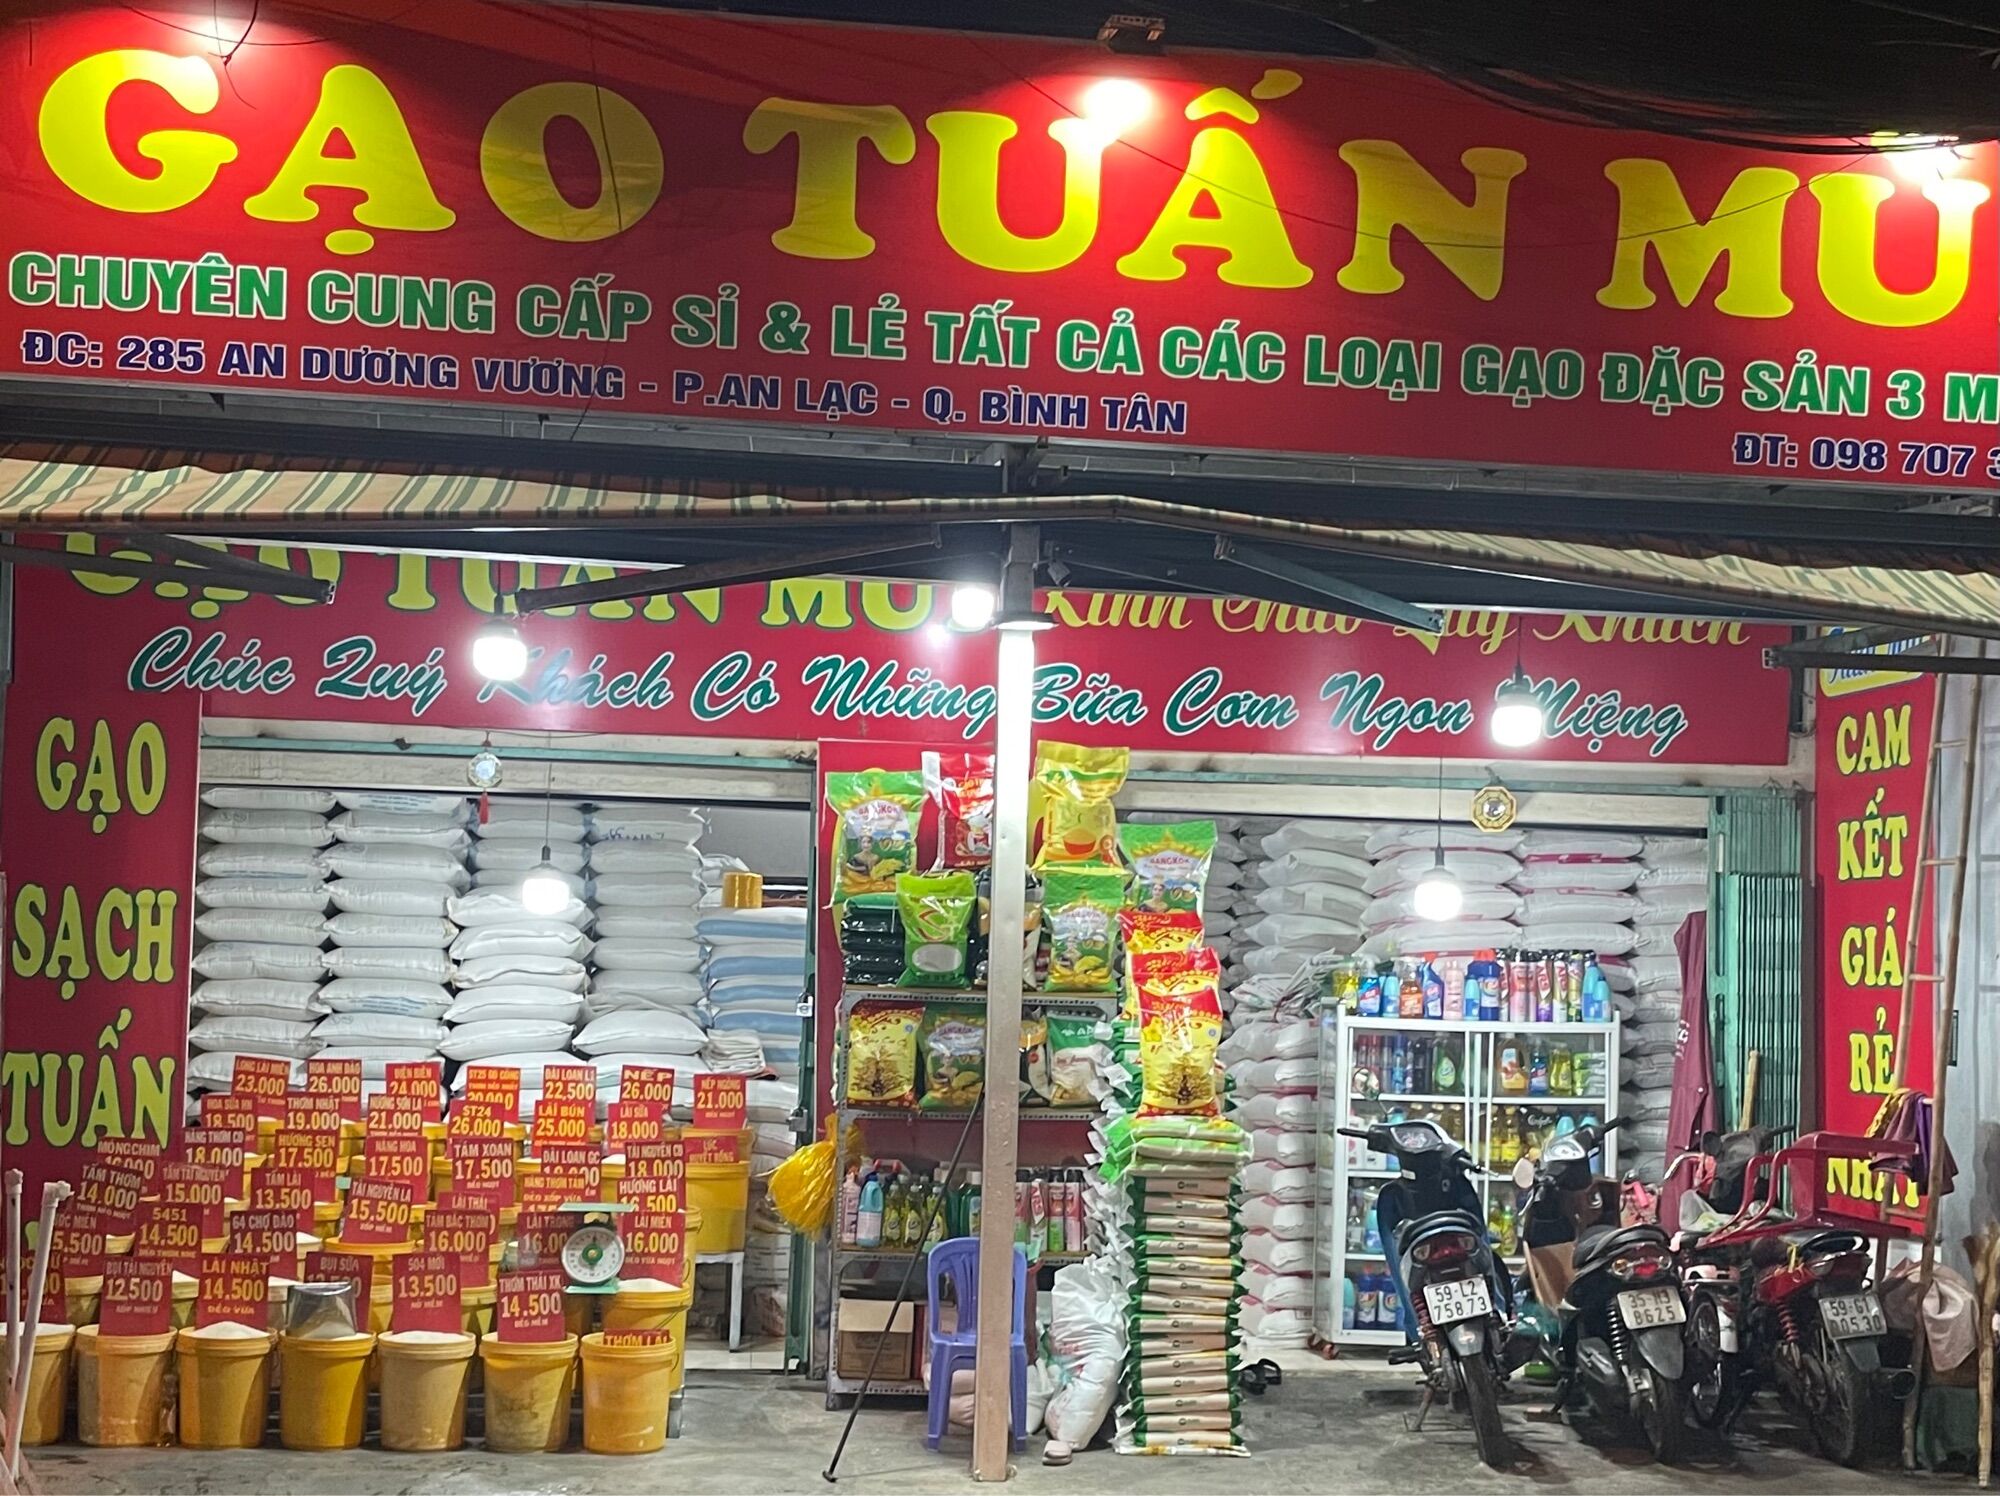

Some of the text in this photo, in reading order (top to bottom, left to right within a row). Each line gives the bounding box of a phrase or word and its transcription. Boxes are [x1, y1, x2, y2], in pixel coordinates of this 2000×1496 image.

[38, 49, 664, 255] GẠO
[742, 69, 1528, 301] TUẤN
[9, 252, 287, 320] CHUYÊN
[308, 270, 495, 334] CUNG
[516, 273, 651, 343] CẤP
[671, 283, 739, 349] SỈ
[759, 301, 810, 354] &
[831, 294, 906, 360] LẺ
[925, 300, 1039, 367] TẤT
[1056, 308, 1143, 376] CẢ
[1159, 320, 1285, 382] CÁC
[1304, 335, 1442, 400] LOẠI
[1461, 344, 1584, 408] GẠO
[1599, 346, 1724, 416] ĐẶC
[1742, 349, 1870, 417] SẢN
[1886, 369, 1925, 420] 3
[22, 330, 1187, 436] ĐC: 285 AN DƯƠNG VƯƠNG P.AN LẠC Q. BÌNH TÂN
[1733, 431, 1976, 478] ĐT: 098 707
[127, 626, 296, 696] Chúc
[315, 635, 448, 717] Quý
[689, 650, 777, 722] Có
[802, 655, 997, 739] Những
[1028, 662, 1148, 726] Bữa
[1163, 666, 1299, 736] Cơm
[1318, 671, 1475, 751] Ngon
[1836, 704, 1912, 775] CAM
[36, 716, 167, 834] GẠO
[1837, 787, 1908, 881] KẾT
[11, 883, 178, 1000] SẠCH
[1841, 906, 1904, 987] GIÁ
[1848, 1006, 1896, 1094] RẺ
[2, 1007, 176, 1150] TUẤN
[235, 1073, 285, 1096] 23.000
[309, 1076, 360, 1094] 26.000
[561, 1069, 583, 1081] LOAN
[623, 1068, 672, 1081] NẾP
[622, 1081, 671, 1101] 26.000
[696, 1091, 743, 1109] 21.000
[287, 1111, 340, 1130] 19.000
[369, 1111, 422, 1130] 21.000
[462, 1105, 491, 1117] ST24
[451, 1116, 501, 1137] 26.000
[536, 1118, 586, 1138] 25.000
[611, 1121, 659, 1139] 18.000
[131, 1142, 160, 1156] CHIM
[314, 1135, 335, 1148] SEN
[482, 1143, 512, 1157] XOAN
[186, 1146, 242, 1168] 18.000
[279, 1147, 334, 1168] 17.500
[369, 1155, 423, 1176] 17.500
[561, 1150, 586, 1164] LOAN
[455, 1158, 512, 1179] 17.500
[629, 1159, 684, 1179] 18.000
[76, 1180, 138, 1210] 14.000
[165, 1183, 221, 1205] 15.000
[619, 1178, 656, 1195] HƯƠNG
[255, 1188, 312, 1210] 13.500
[152, 1207, 187, 1221] 5451
[232, 1215, 246, 1229] 64
[348, 1198, 408, 1225] 15.500
[139, 1222, 198, 1247] 14.500
[234, 1231, 295, 1254] 14.500
[429, 1230, 486, 1253] 16.000
[626, 1231, 679, 1254] 16.000
[230, 1257, 270, 1277] NHẬT
[203, 1278, 265, 1301] 14.500
[398, 1274, 457, 1298] 13.500
[1434, 1280, 1478, 1303] 59-L2
[501, 1291, 562, 1318] 14.500
[1633, 1305, 1676, 1326] 8625
